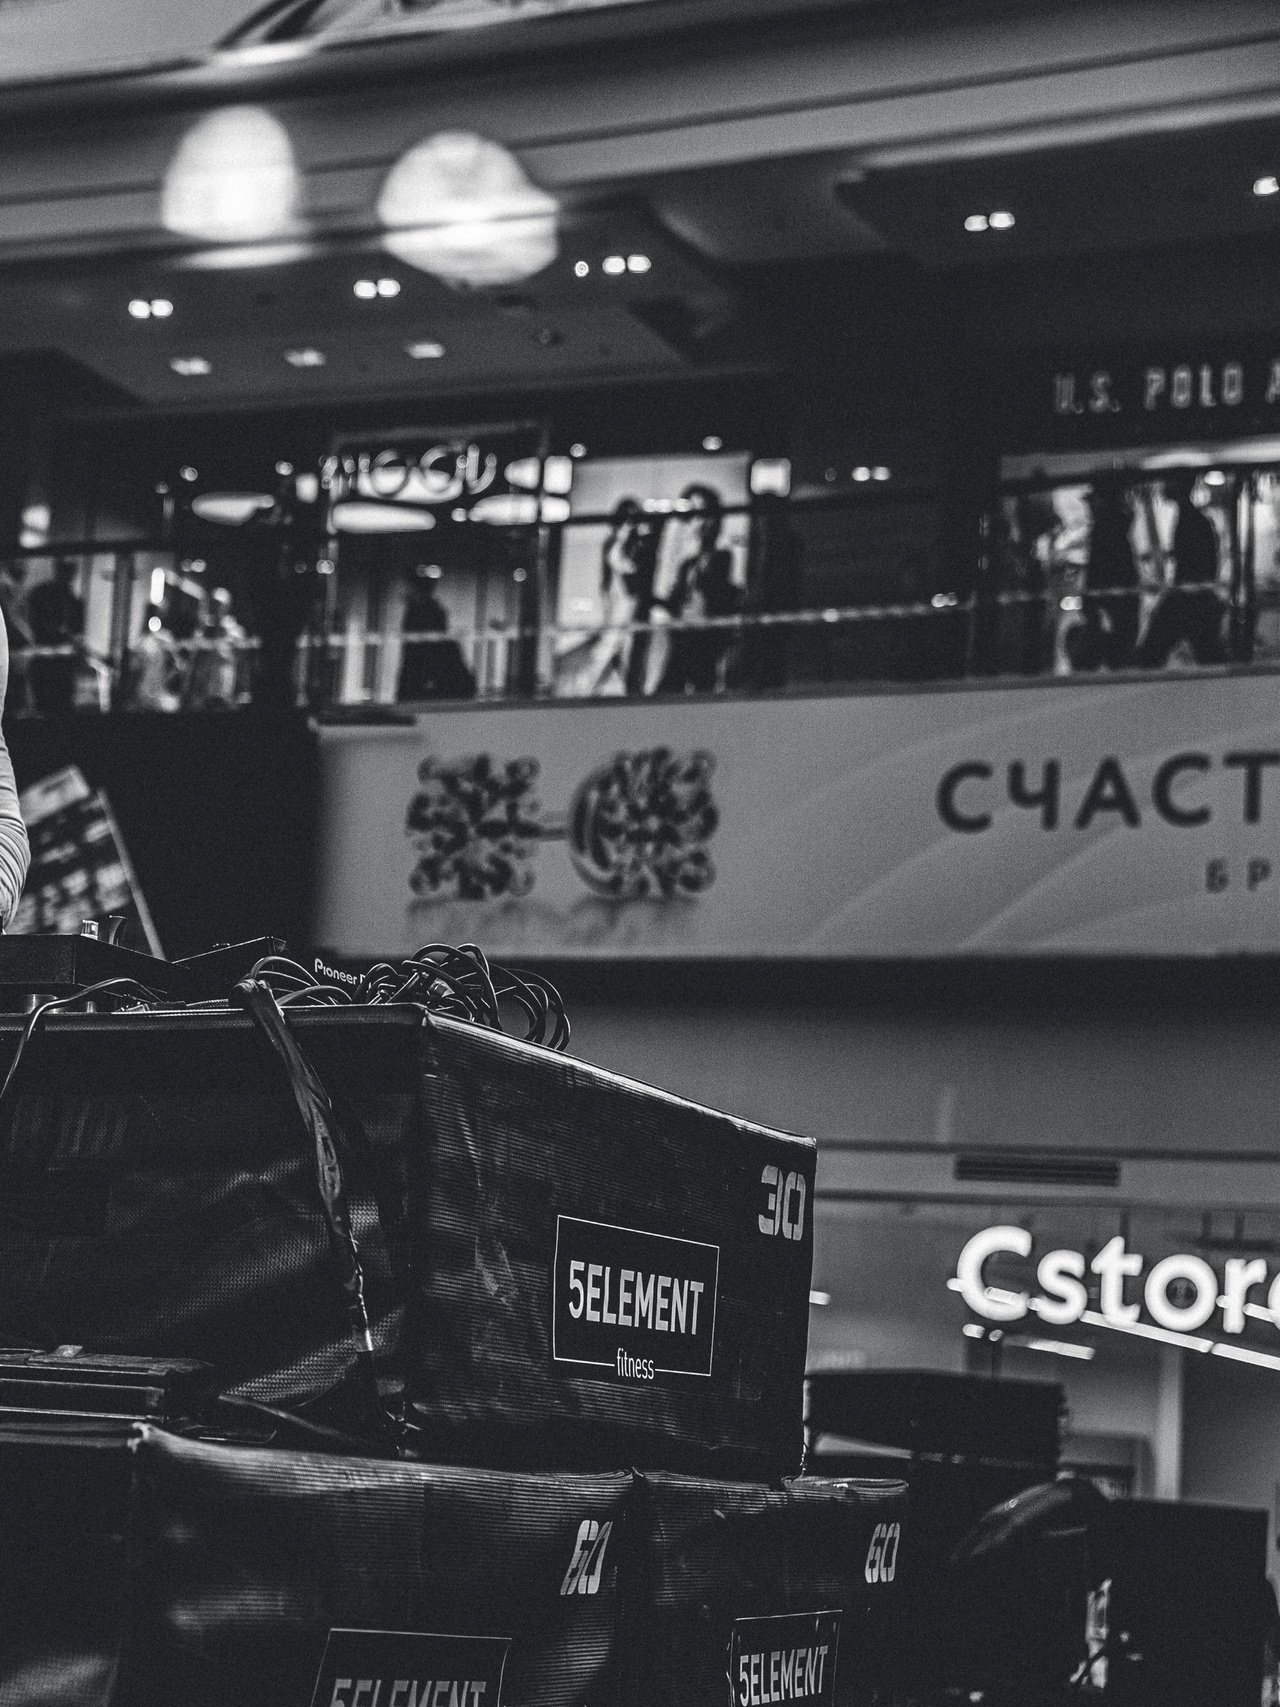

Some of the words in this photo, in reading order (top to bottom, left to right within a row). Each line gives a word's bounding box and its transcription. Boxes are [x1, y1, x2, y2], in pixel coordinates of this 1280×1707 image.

[1055, 371, 1120, 414] U.S.
[1144, 361, 1243, 410] POLO
[935, 752, 1280, 835] СЧАСТ
[314, 958, 358, 985] Pioneer
[758, 1165, 807, 1241] 30
[569, 1260, 705, 1335] 5ELEMENT
[956, 1225, 1280, 1334] Cstor
[616, 1348, 655, 1380] fitness
[865, 1522, 901, 1583] 60
[740, 1645, 829, 1707] 5ELEMENT
